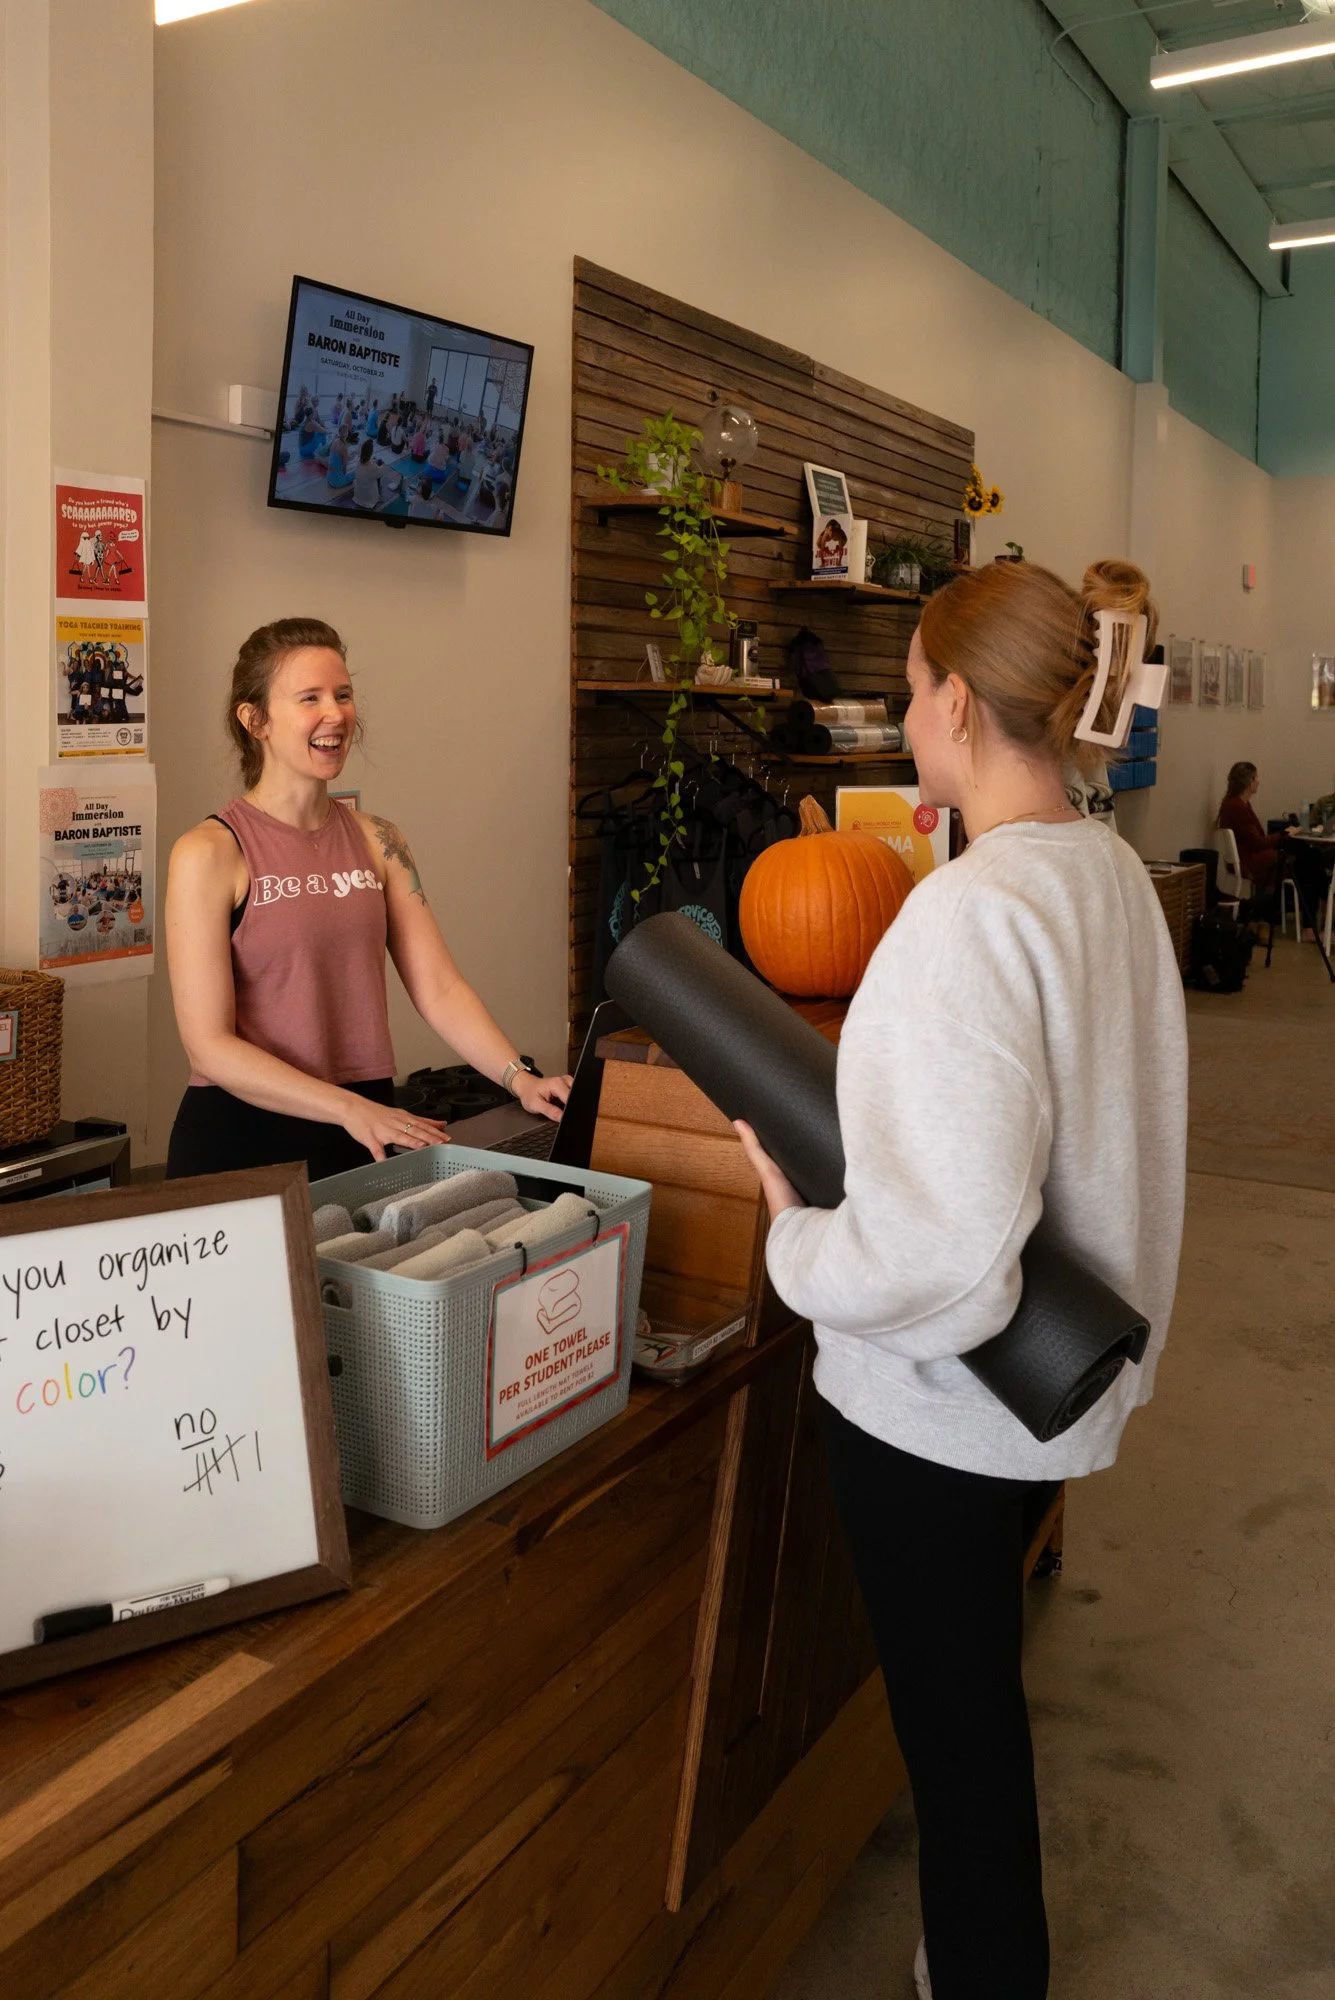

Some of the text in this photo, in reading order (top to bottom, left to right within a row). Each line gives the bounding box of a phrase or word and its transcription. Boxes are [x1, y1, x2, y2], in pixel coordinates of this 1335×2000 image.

[329, 315, 385, 341] Immersion
[345, 310, 371, 325] All Day
[308, 332, 400, 368] BARON BAPTISTE
[352, 365, 378, 377] OCTOBER
[80, 622, 108, 630] TEACHER
[110, 623, 142, 631] TRAINING
[72, 810, 124, 821] Immersion
[96, 803, 109, 811] Day
[54, 825, 141, 841] BARON BAPTISTE
[254, 869, 383, 906] Be a yes.
[3, 1229, 229, 1319] you organize
[36, 1304, 126, 1350] closet
[151, 1296, 193, 1339] by
[525, 1327, 588, 1370] ONE TOWEL
[16, 1346, 137, 1415] color?
[499, 1331, 611, 1404] PER STUDENT PLEASE
[516, 1399, 549, 1420] AVAILABLE
[550, 1393, 559, 1402] TO
[560, 1382, 574, 1396] RENT
[575, 1375, 587, 1387] FOR
[517, 1396, 532, 1409] FULL
[533, 1385, 557, 1401] LENGTH
[559, 1374, 570, 1386] MAT
[173, 1407, 218, 1440] no
